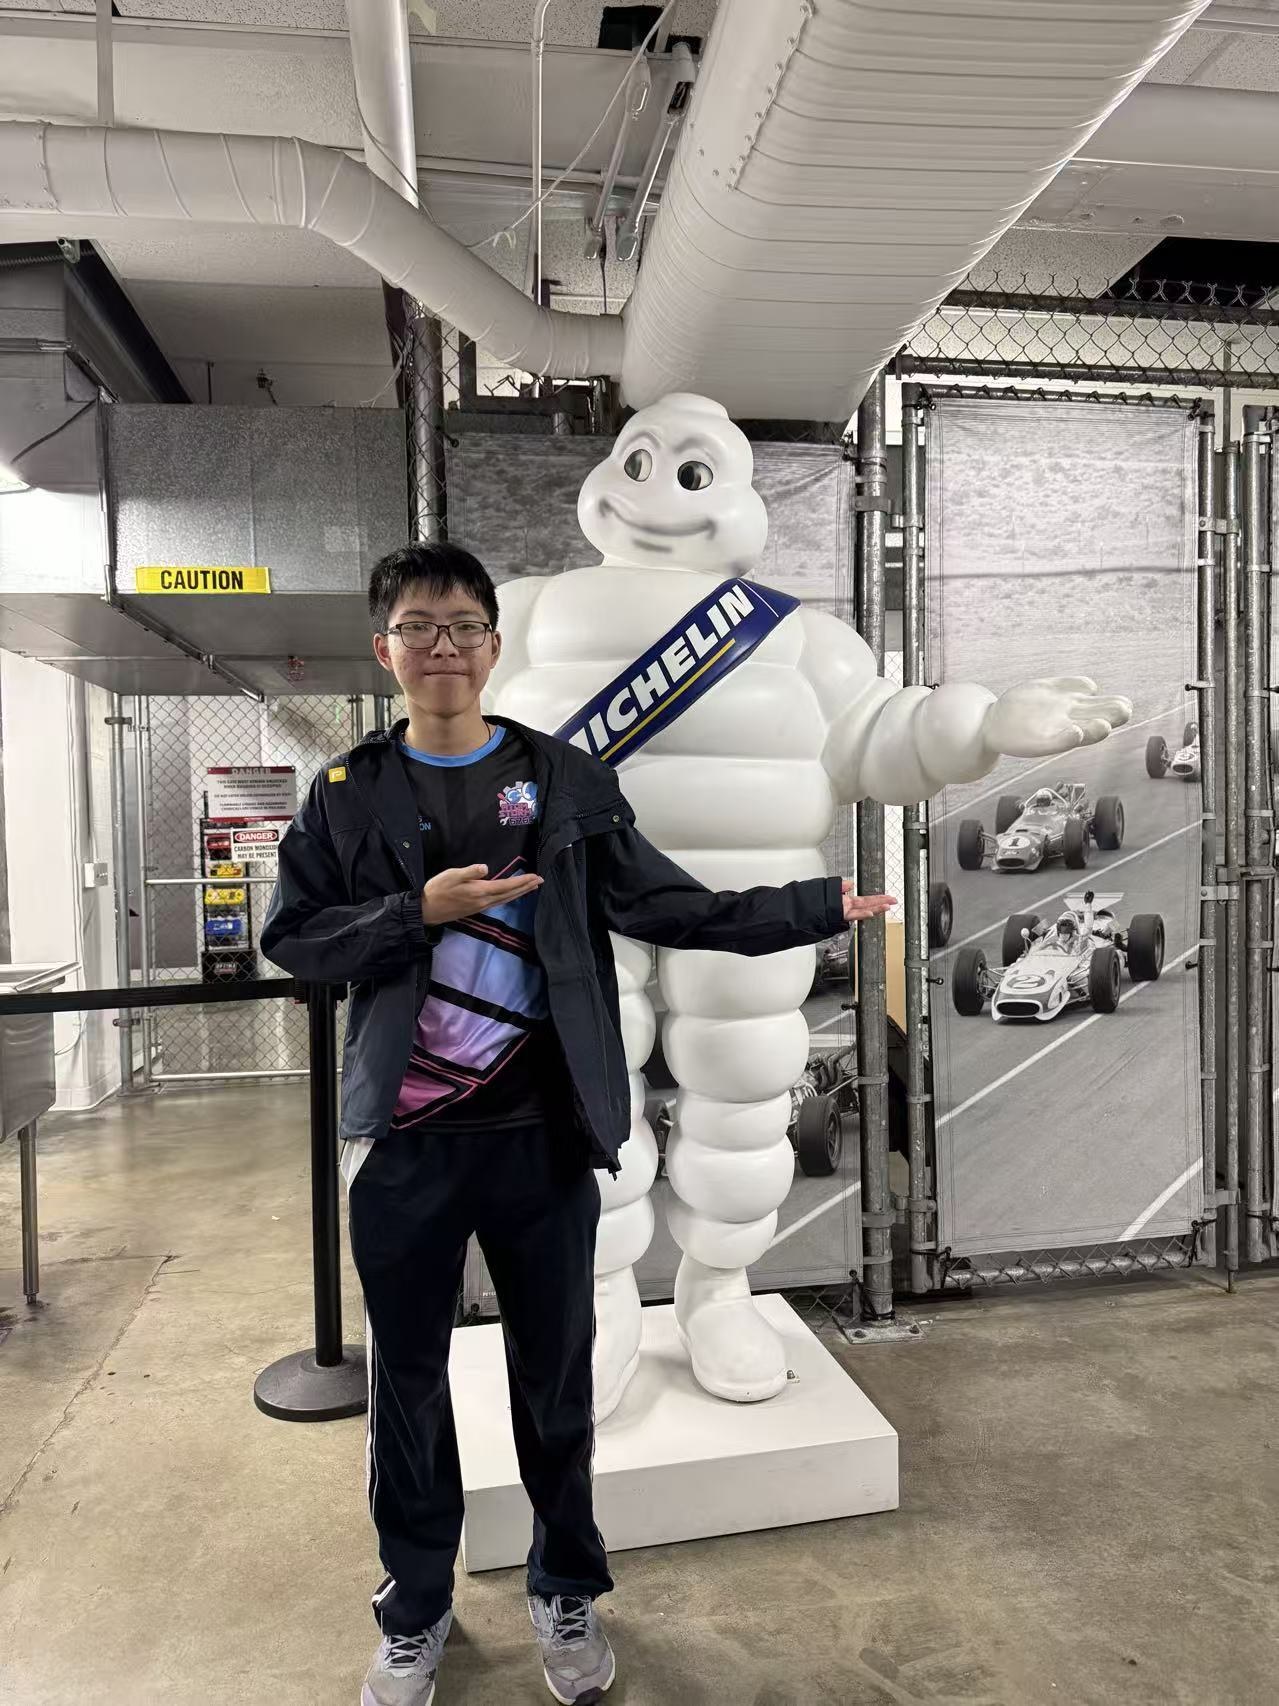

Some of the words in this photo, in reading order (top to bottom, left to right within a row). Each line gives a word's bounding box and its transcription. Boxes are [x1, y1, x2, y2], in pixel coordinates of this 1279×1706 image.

[160, 569, 243, 590] CAUTION
[231, 767, 271, 775] DANGER
[239, 832, 273, 840] DANGER
[1008, 837, 1020, 847] 1
